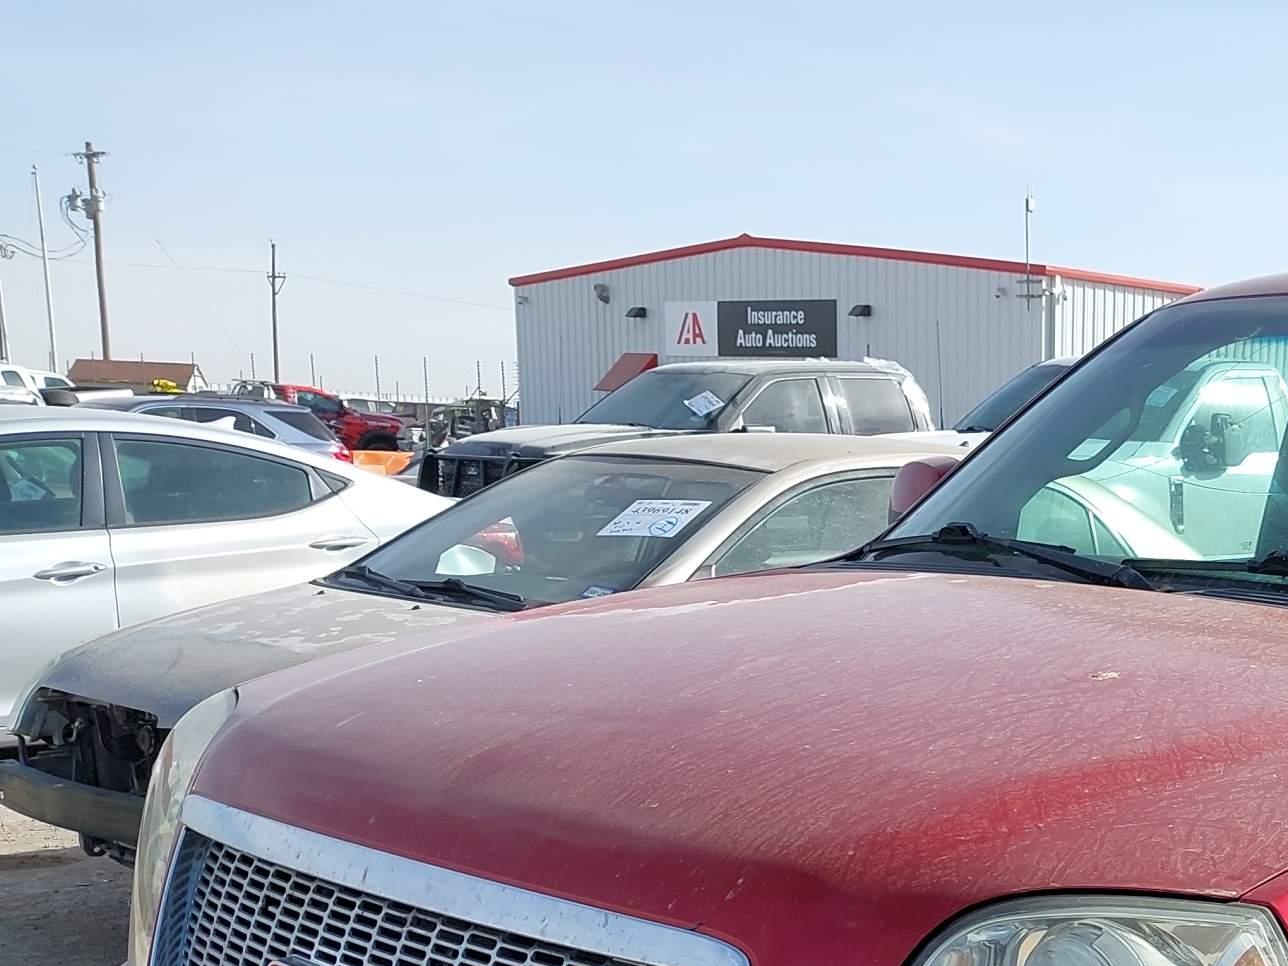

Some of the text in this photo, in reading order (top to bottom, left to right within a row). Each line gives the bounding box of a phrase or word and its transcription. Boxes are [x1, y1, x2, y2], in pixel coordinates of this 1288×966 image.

[747, 306, 805, 325] Insurance
[736, 329, 817, 348] Auto Auctions
